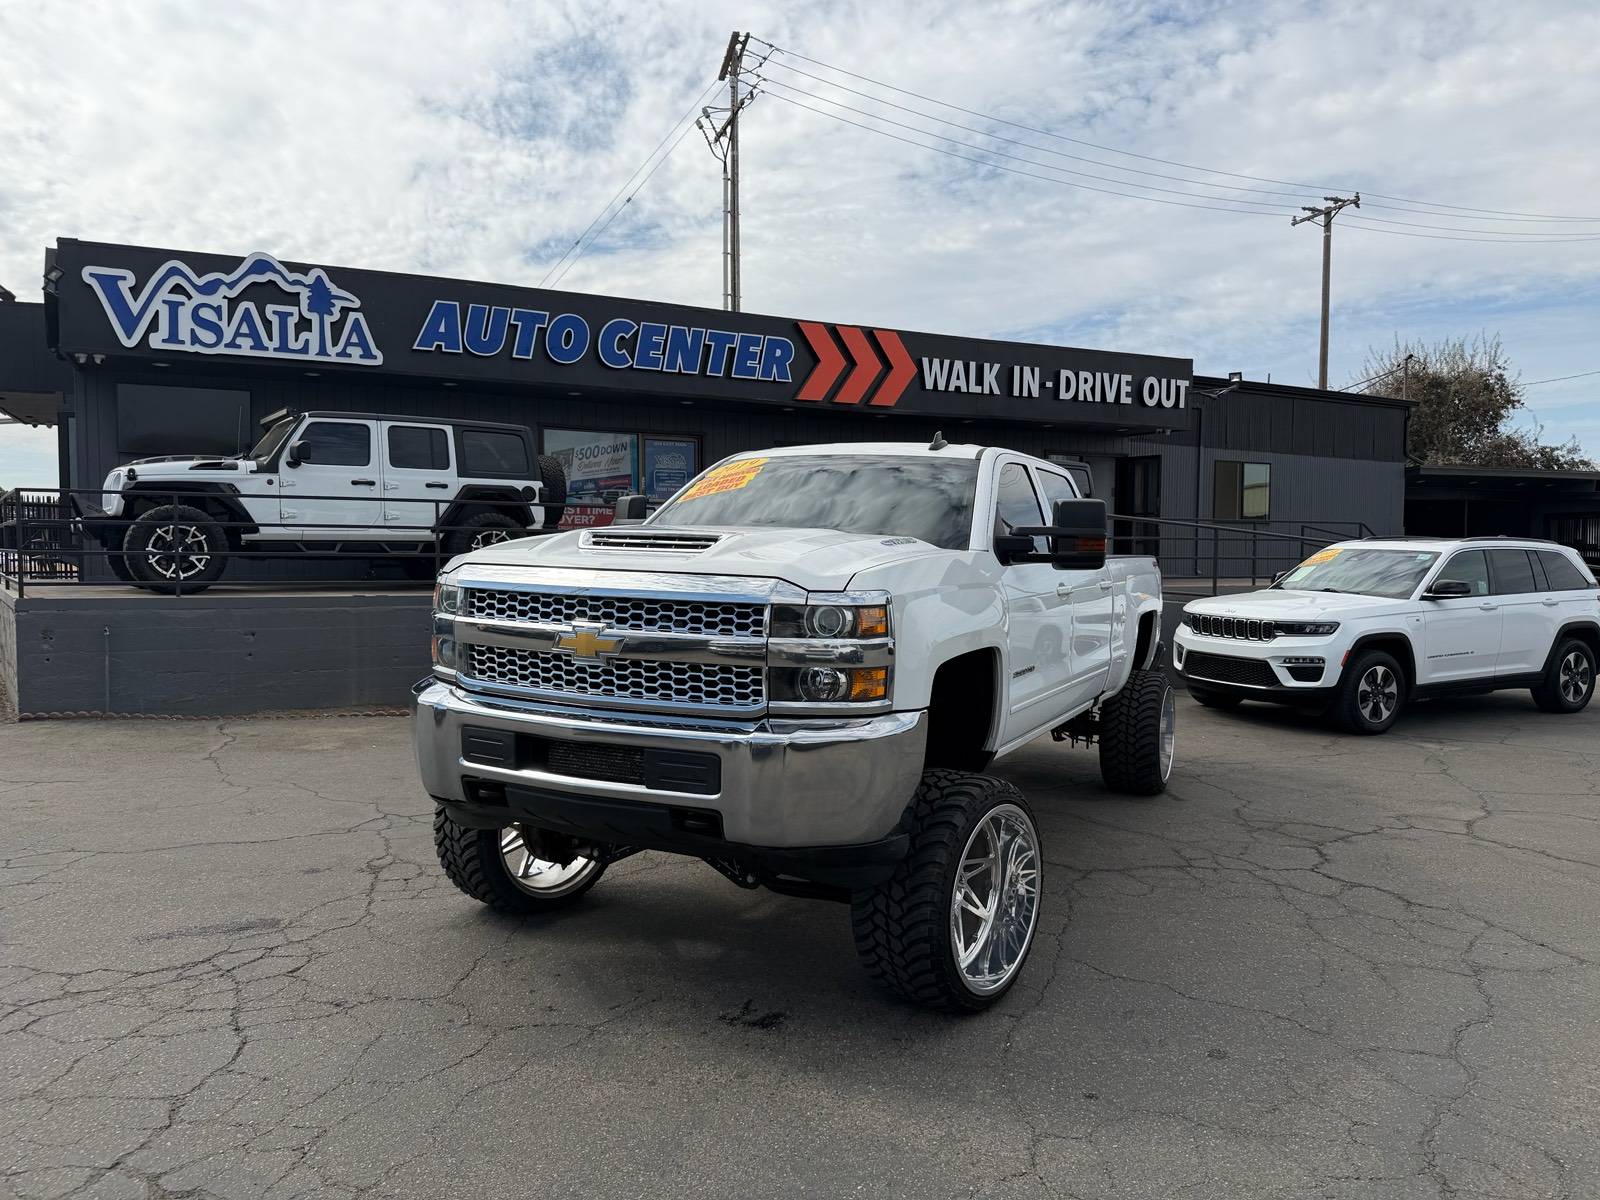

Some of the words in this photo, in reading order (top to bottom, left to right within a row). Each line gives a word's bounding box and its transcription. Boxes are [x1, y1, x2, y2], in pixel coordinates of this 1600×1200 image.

[82, 253, 384, 366] VISALIA
[413, 300, 590, 364] AUTO
[598, 318, 795, 383] CENTER
[921, 357, 1001, 395] WALK
[1142, 376, 1190, 409] OUT
[575, 444, 600, 461] $500
[600, 441, 628, 455] DOWN
[586, 507, 614, 515] TIME
